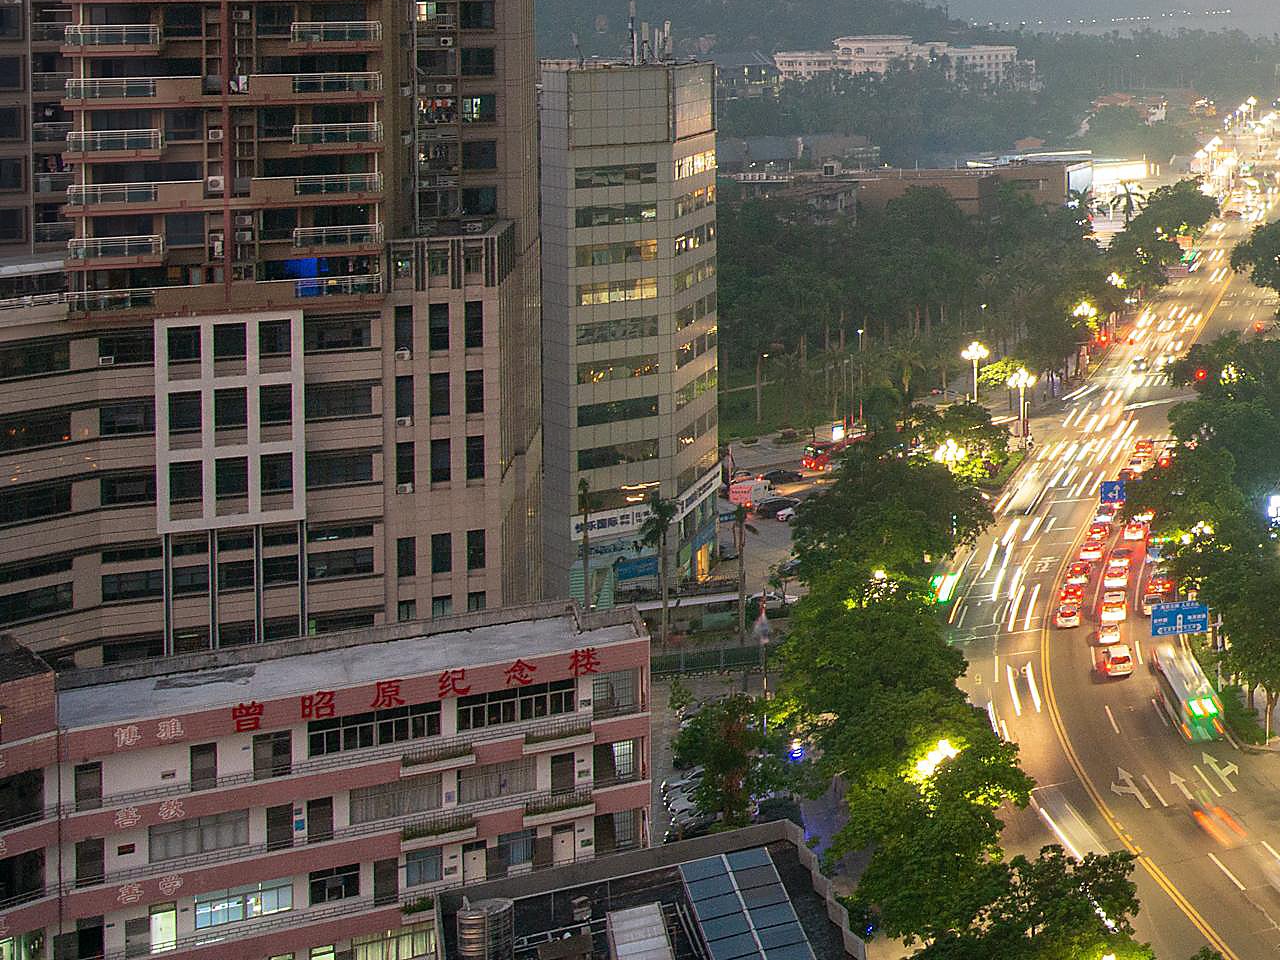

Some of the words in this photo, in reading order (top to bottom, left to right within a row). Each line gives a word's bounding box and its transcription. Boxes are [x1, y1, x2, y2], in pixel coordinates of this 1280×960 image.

[231, 648, 600, 733] 曾昭原纪念楼
[114, 718, 184, 748] 博雅
[114, 799, 185, 828] 善教
